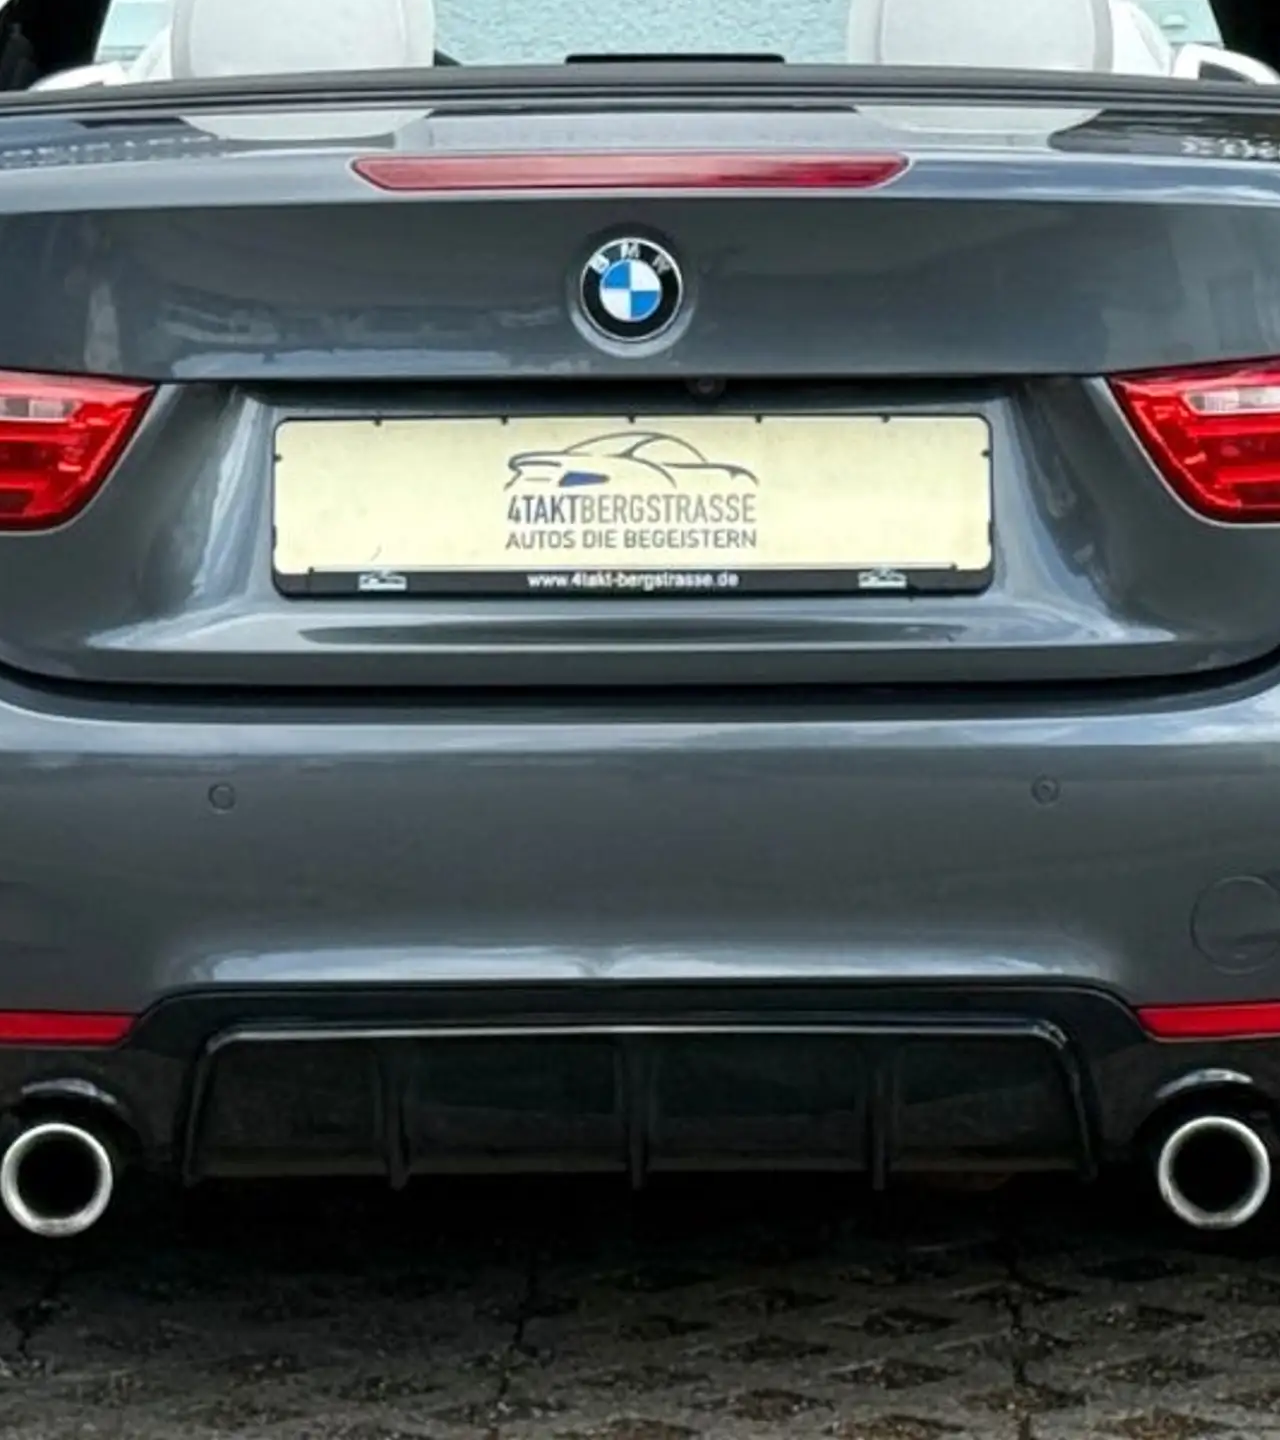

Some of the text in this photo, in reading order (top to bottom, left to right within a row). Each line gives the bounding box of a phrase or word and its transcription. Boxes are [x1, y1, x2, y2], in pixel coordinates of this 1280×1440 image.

[588, 241, 671, 274] BMW
[507, 493, 757, 524] 4TAKTBERGSTRASSE
[505, 529, 757, 549] AUTOS DIE BEGEISTERN
[527, 572, 739, 591] www.4takt-bergstrasse.de
